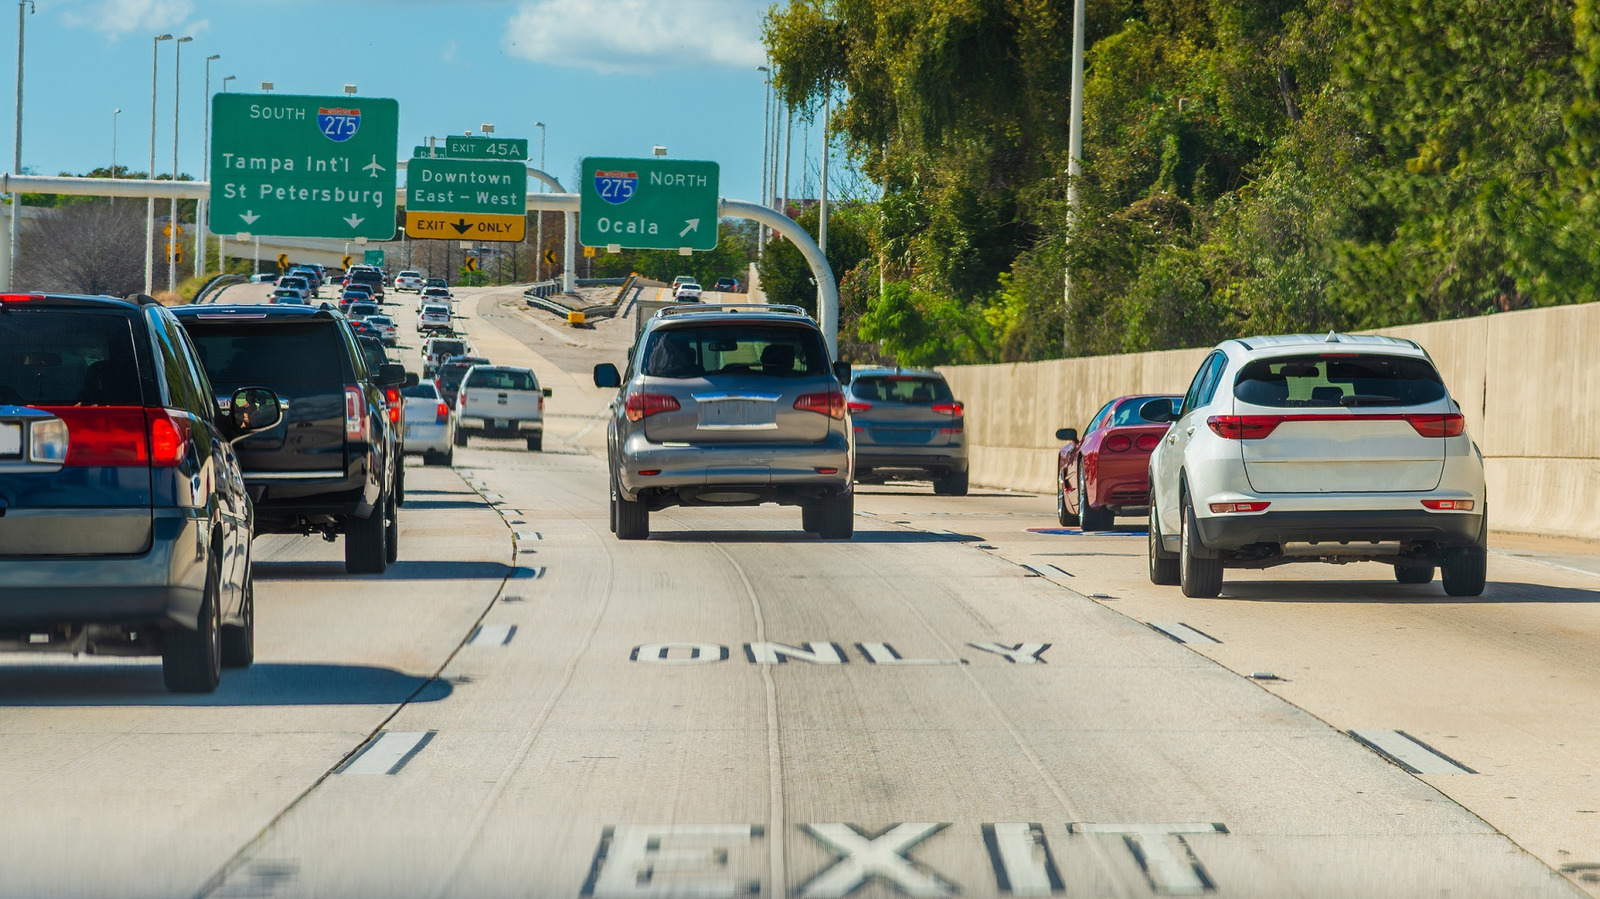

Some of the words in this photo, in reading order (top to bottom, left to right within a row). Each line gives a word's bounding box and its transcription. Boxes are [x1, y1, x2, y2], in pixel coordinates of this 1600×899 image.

[250, 104, 305, 120] SOUTH
[325, 116, 357, 135] 275
[452, 143, 476, 152] EXIT
[486, 143, 520, 156] 45A
[223, 153, 294, 173] Tampa
[307, 156, 349, 172] Int'l
[422, 169, 511, 185] Downtown
[650, 171, 707, 187] NORTH
[224, 183, 246, 198] St
[260, 184, 383, 208] Petersburg
[602, 179, 633, 198] 275
[415, 189, 454, 203] East
[476, 191, 518, 206] West
[417, 220, 446, 230] EXIT
[478, 222, 513, 233] ONLY
[598, 217, 658, 234] Ocala
[629, 642, 1053, 665] ONLY
[578, 822, 1230, 897] EXIT
